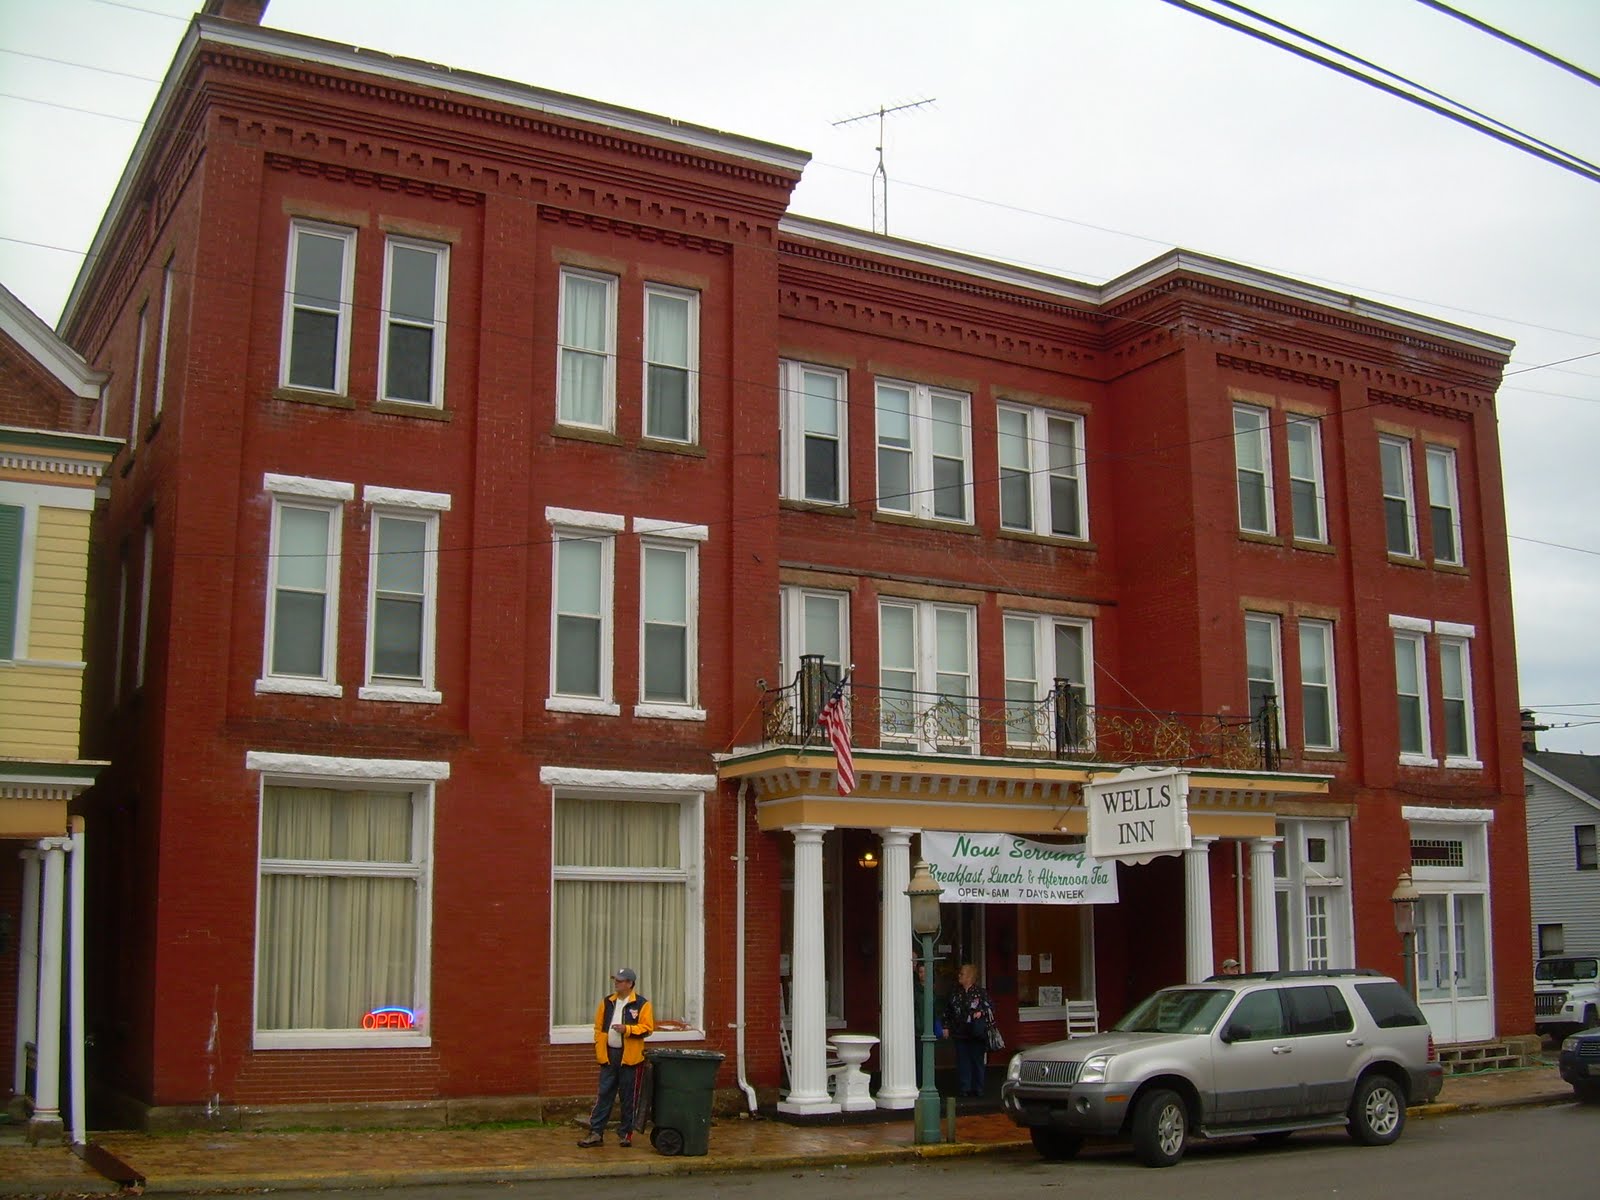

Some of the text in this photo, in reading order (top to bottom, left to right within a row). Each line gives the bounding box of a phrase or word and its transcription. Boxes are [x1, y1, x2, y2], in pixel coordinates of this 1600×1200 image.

[1101, 784, 1171, 815] WELLS
[1118, 819, 1155, 845] INN
[952, 835, 1086, 868] Now Serving
[929, 863, 1109, 889] Breakfast, Lunch & Afternoon Tea
[958, 887, 985, 898] OPEN
[991, 888, 1010, 898] 6AM
[1019, 888, 1025, 898] 7
[1026, 889, 1049, 899] DAYS
[1050, 890, 1057, 899] A
[1057, 889, 1085, 900] WEEK
[363, 1013, 410, 1029] OPEN
